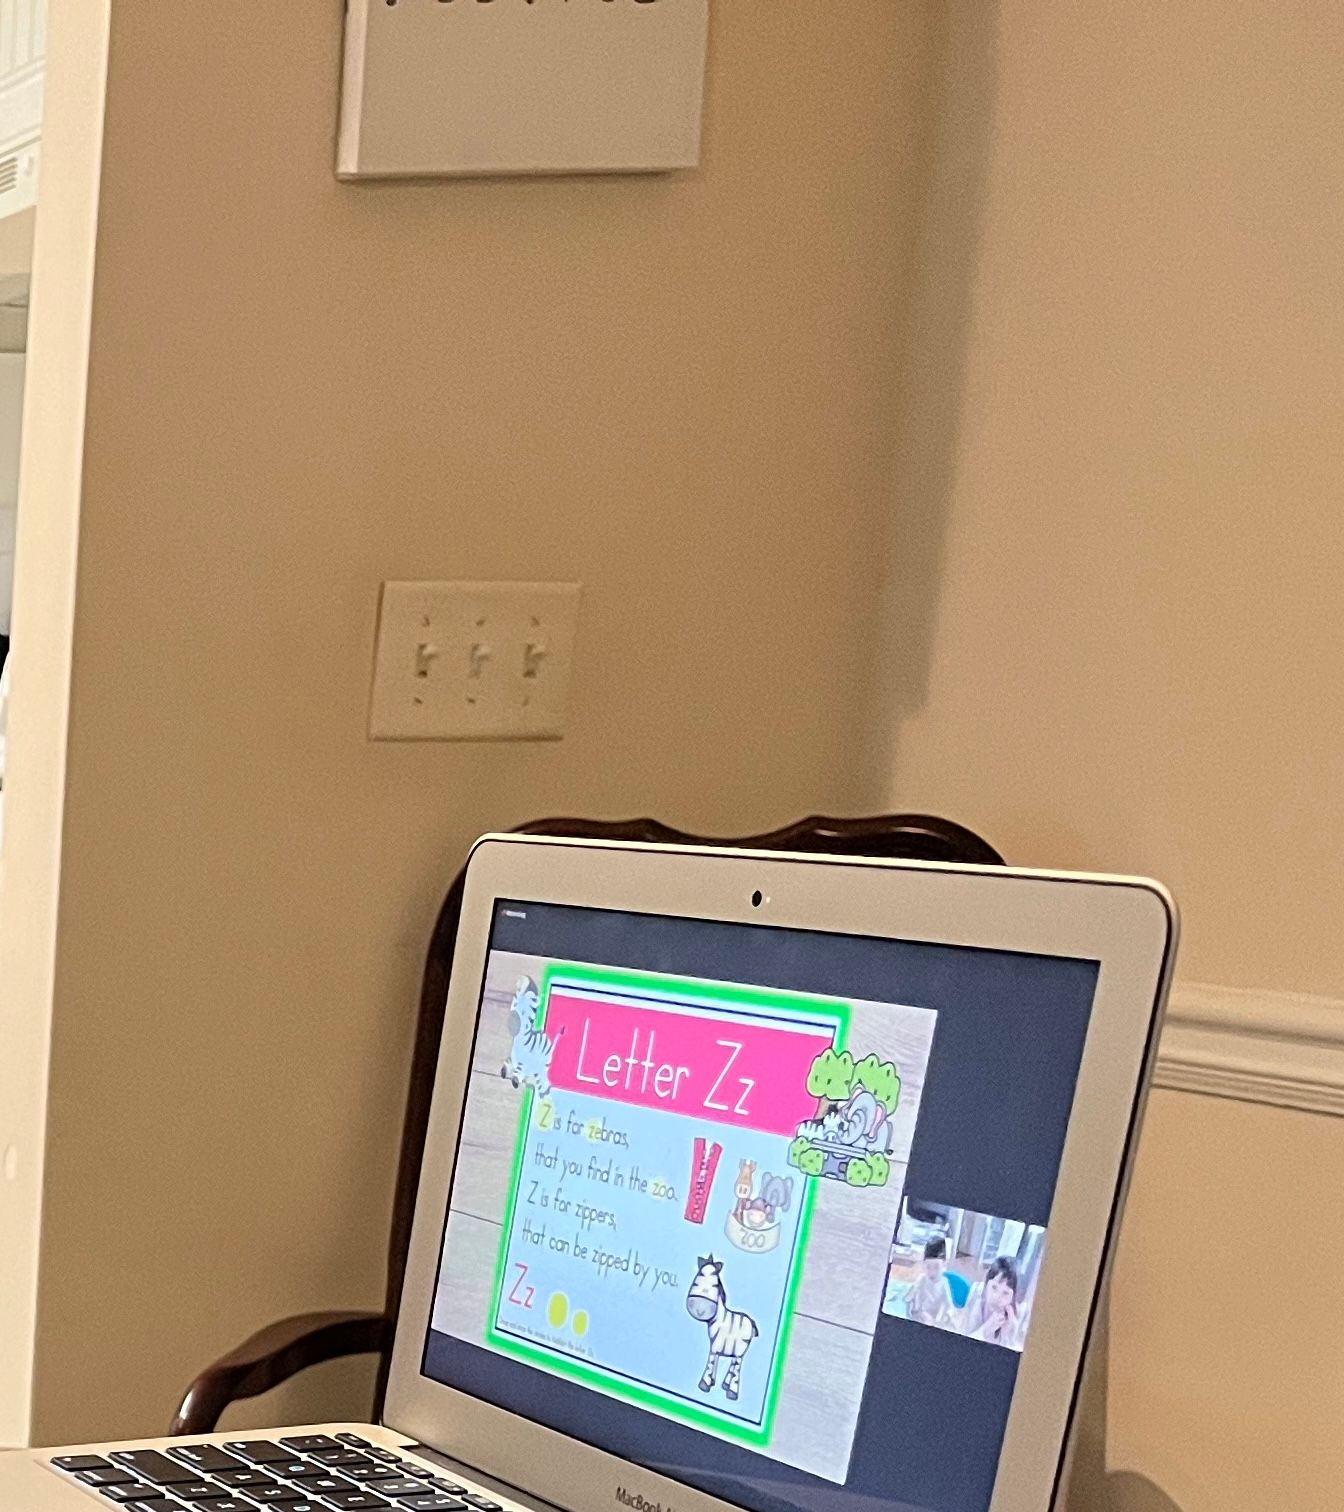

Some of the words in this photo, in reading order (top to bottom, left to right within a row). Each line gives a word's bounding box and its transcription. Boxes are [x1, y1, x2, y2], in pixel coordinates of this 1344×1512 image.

[575, 1017, 691, 1101] Letter
[702, 1039, 756, 1116] Zz
[538, 1102, 553, 1129] Z
[553, 1111, 562, 1131] is
[566, 1109, 585, 1136] for
[588, 1116, 630, 1150] zebras,
[534, 1142, 559, 1169] that
[559, 1159, 584, 1183] you
[587, 1155, 613, 1183] find
[613, 1166, 625, 1187] in
[628, 1162, 648, 1193] the
[526, 1179, 539, 1205] Z
[540, 1188, 550, 1208] is
[553, 1187, 572, 1213] for
[575, 1199, 618, 1232] zippers,
[521, 1217, 546, 1246] that
[548, 1236, 570, 1256] can
[573, 1231, 588, 1260] be
[591, 1243, 632, 1279] zipped
[633, 1250, 650, 1288] by
[650, 1267, 680, 1293] you.
[508, 1262, 535, 1309] Zz
